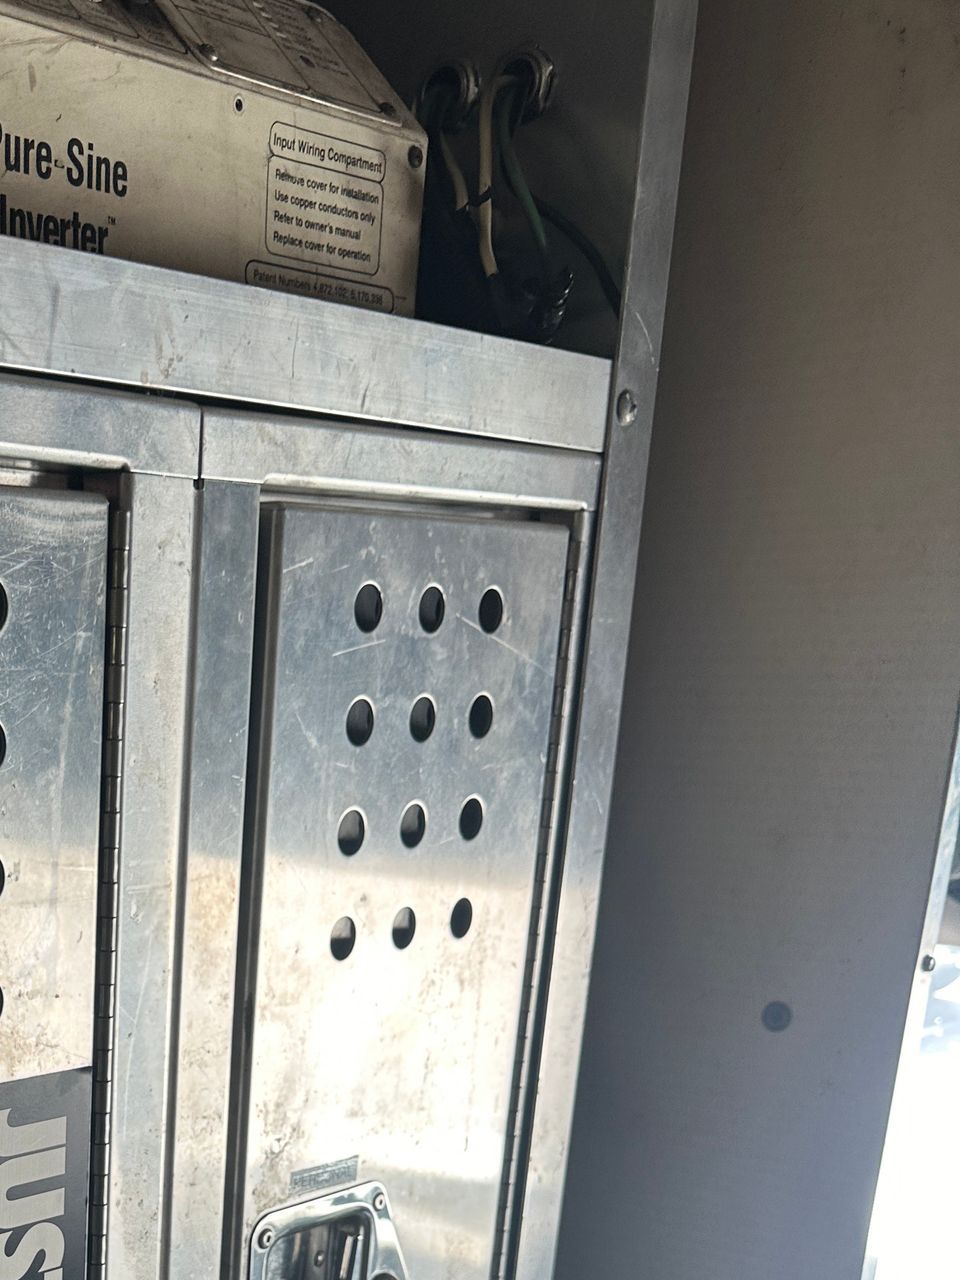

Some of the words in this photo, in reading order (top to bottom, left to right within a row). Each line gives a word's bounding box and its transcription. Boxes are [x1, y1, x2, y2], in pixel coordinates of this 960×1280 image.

[273, 133, 296, 151] Input
[298, 139, 326, 161] Wiring
[327, 147, 382, 173] Compartment
[275, 168, 305, 187] Remove
[306, 178, 327, 192] cover
[329, 182, 340, 194] for
[340, 184, 379, 204] installation
[273, 210, 294, 225] Refer
[295, 216, 303, 228] to
[304, 219, 333, 235] owner's
[334, 226, 362, 240] manual
[274, 189, 289, 202] Use
[290, 195, 317, 210] copper
[318, 202, 359, 220] conductors
[359, 211, 376, 226] only
[273, 231, 303, 249] Replace
[304, 239, 325, 253] cover
[326, 242, 337, 255] for
[337, 246, 371, 262] operation
